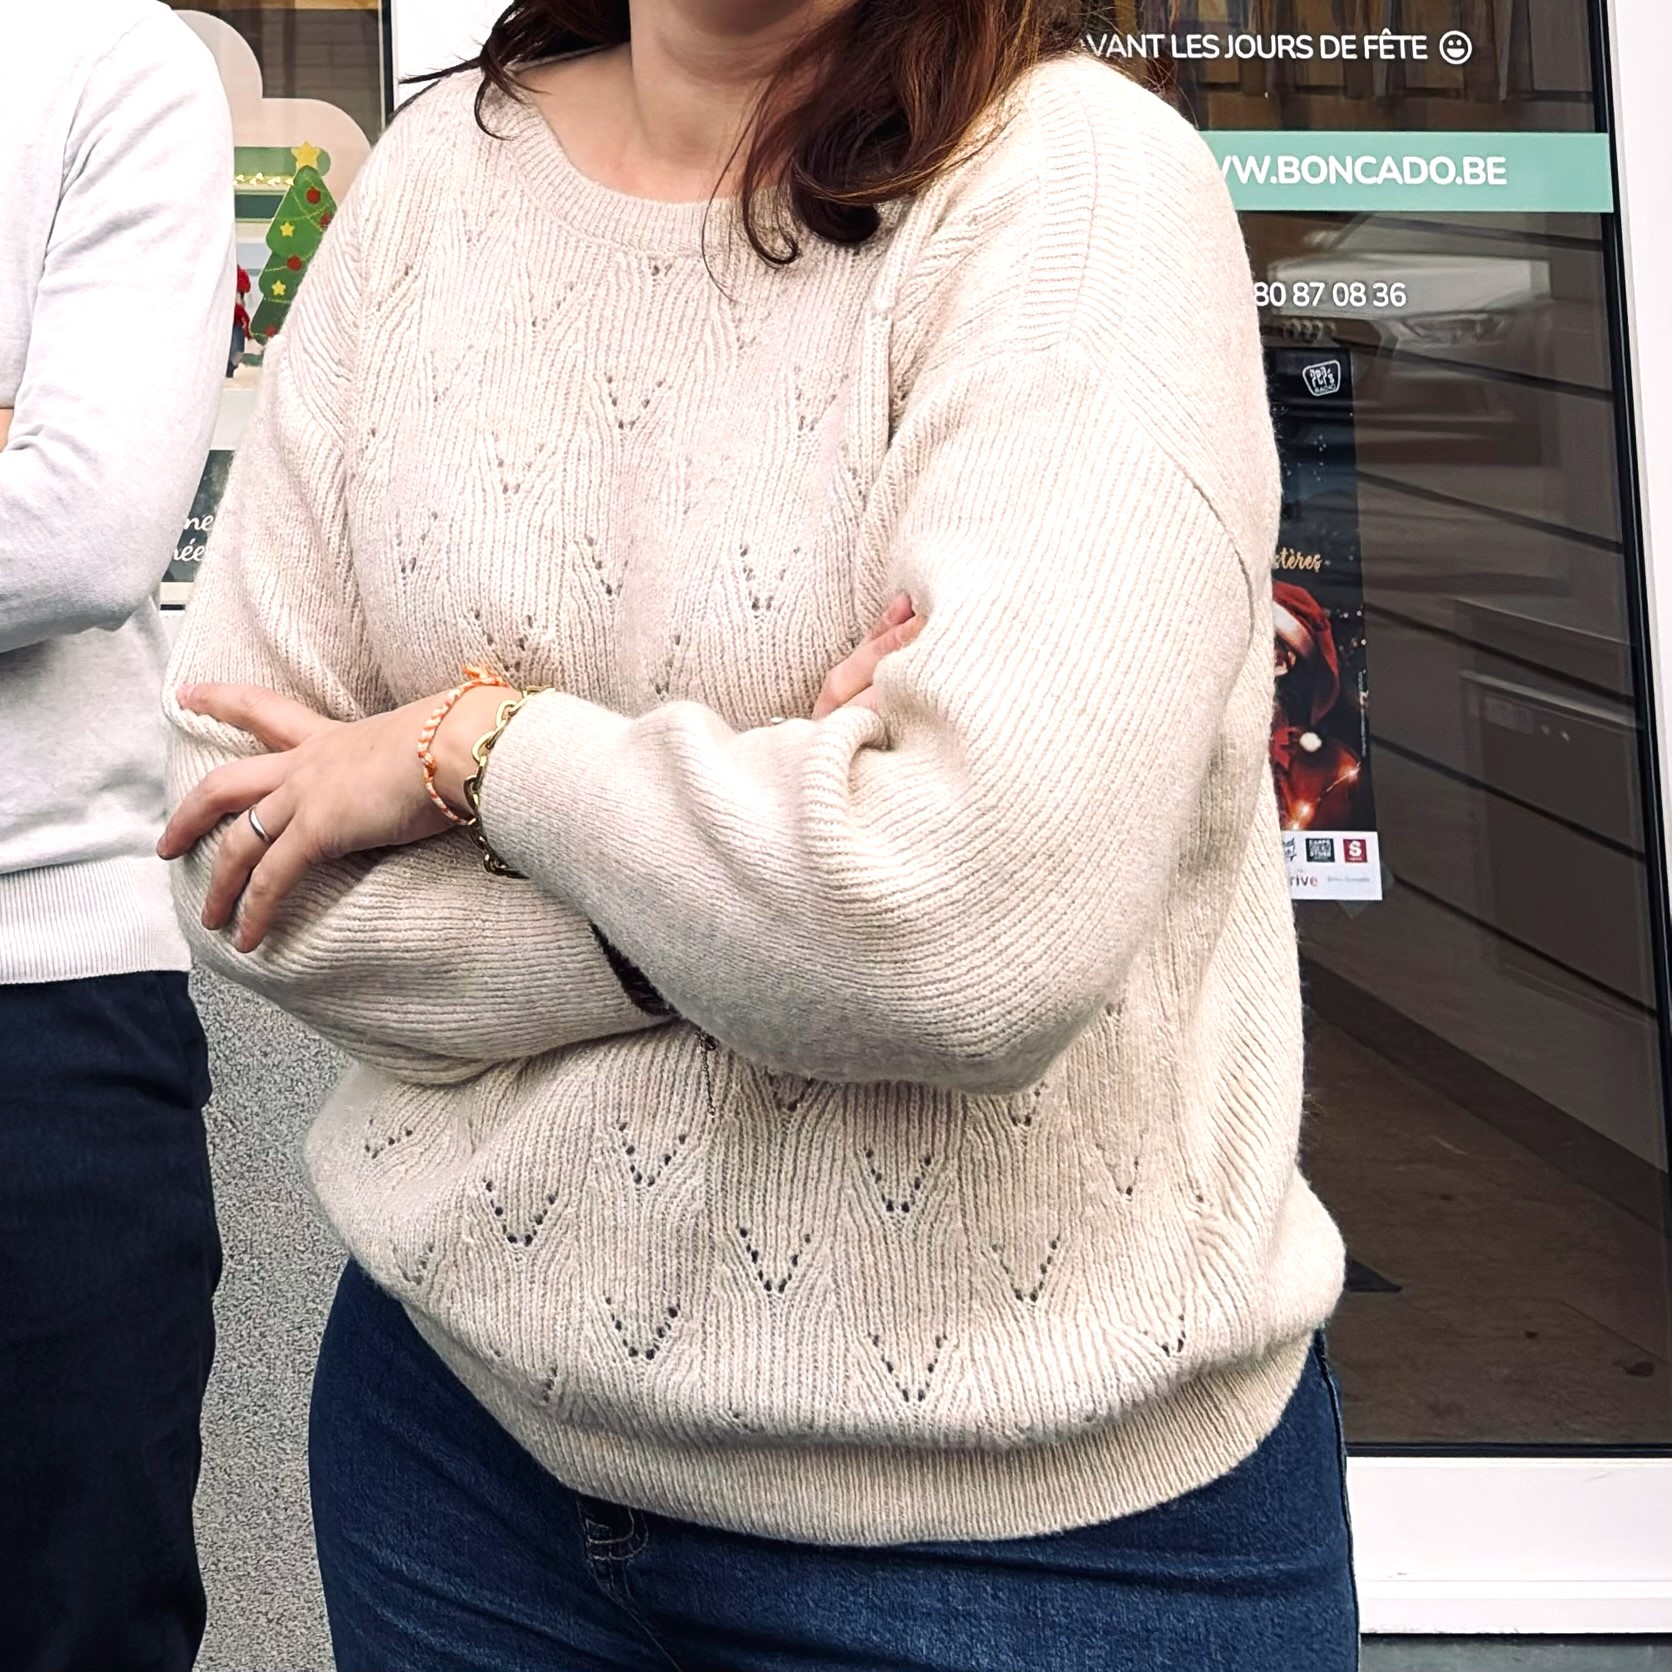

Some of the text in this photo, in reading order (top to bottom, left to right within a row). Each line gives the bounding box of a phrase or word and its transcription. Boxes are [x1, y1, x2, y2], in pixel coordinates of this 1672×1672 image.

[1171, 33, 1220, 60] LES
[1224, 33, 1315, 60] JOURS
[1320, 35, 1358, 60] DE
[1364, 27, 1429, 61] FÊTE
[1292, 282, 1325, 308] 87
[1332, 282, 1367, 308] 08
[1372, 282, 1407, 308] 36
